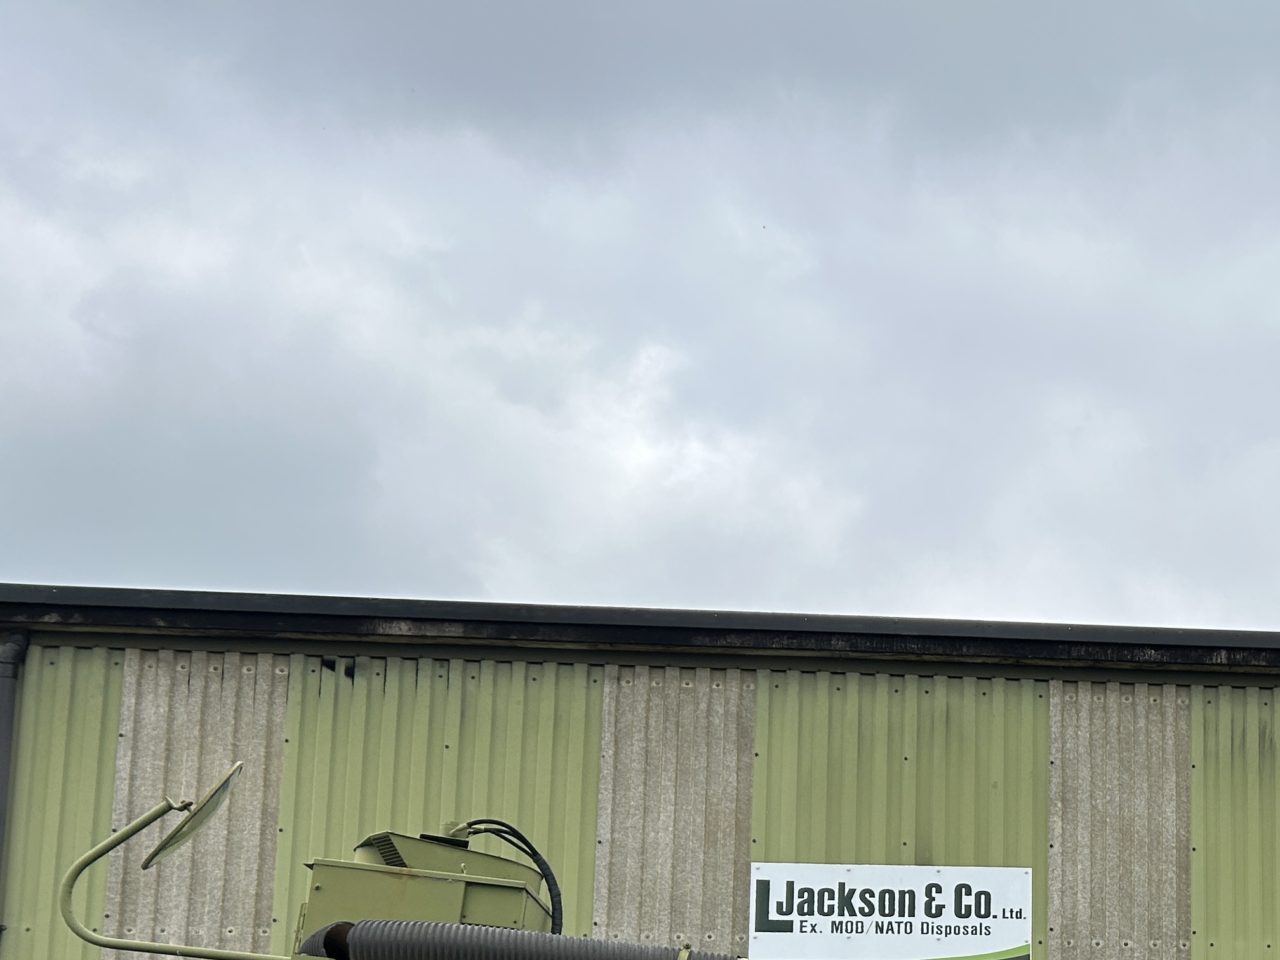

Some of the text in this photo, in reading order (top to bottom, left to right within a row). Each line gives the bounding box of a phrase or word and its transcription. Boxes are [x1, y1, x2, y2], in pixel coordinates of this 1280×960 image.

[924, 883, 946, 919] &
[954, 883, 998, 919] Co.
[1002, 908, 1027, 920] Ltd.
[799, 920, 992, 938] Ex. MOD/NATO Disposals
